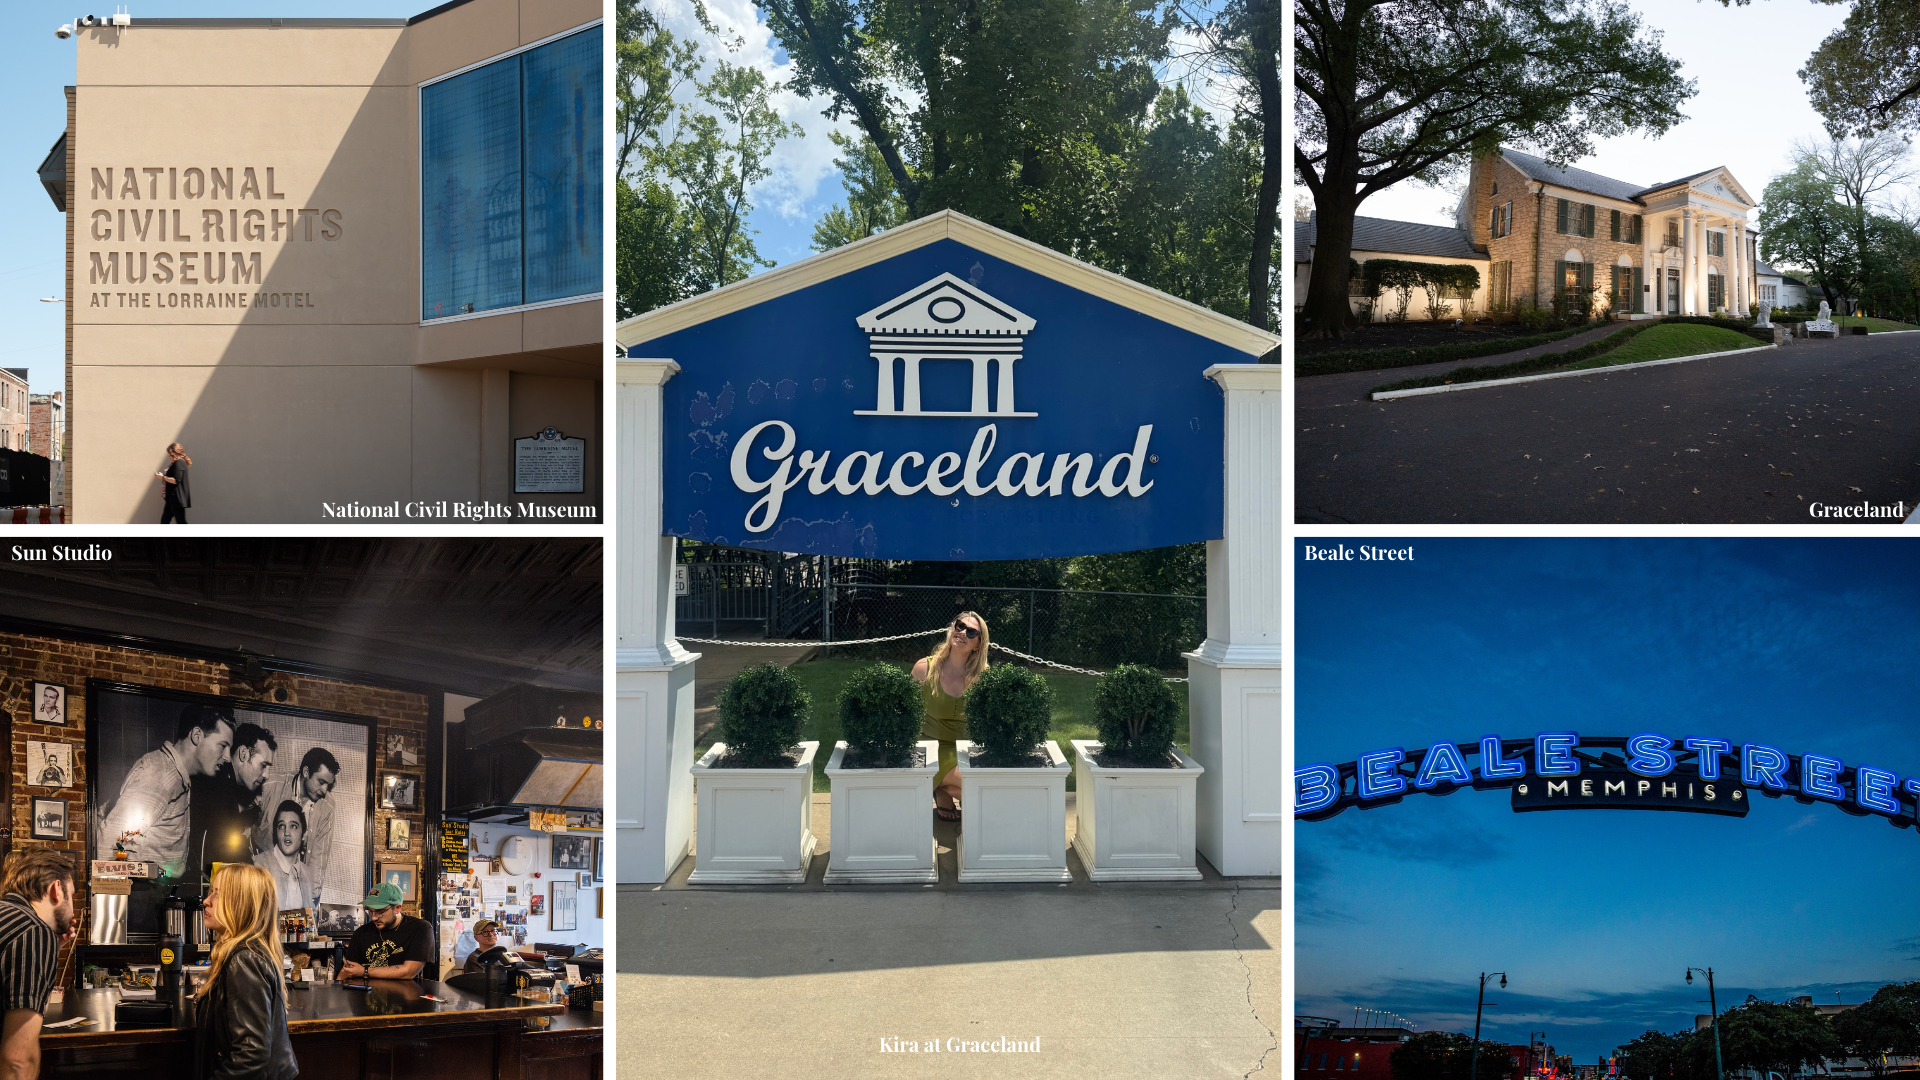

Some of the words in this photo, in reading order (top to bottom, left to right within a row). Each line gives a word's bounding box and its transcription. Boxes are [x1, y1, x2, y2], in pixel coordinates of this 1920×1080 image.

[90, 167, 285, 200] NATIONAL
[90, 208, 191, 242] CIVIL
[202, 208, 343, 242] RIGHTS
[89, 252, 262, 285] MUSEUM
[90, 293, 111, 308] AT
[117, 293, 151, 308] THE
[157, 293, 248, 308] LORRAINE
[254, 293, 315, 309] MOTEL
[730, 420, 1154, 533] Graceland
[1294, 731, 1581, 815] BEALE
[1547, 779, 1716, 801] MEMPHIS
[97, 862, 136, 874] ELVIS
